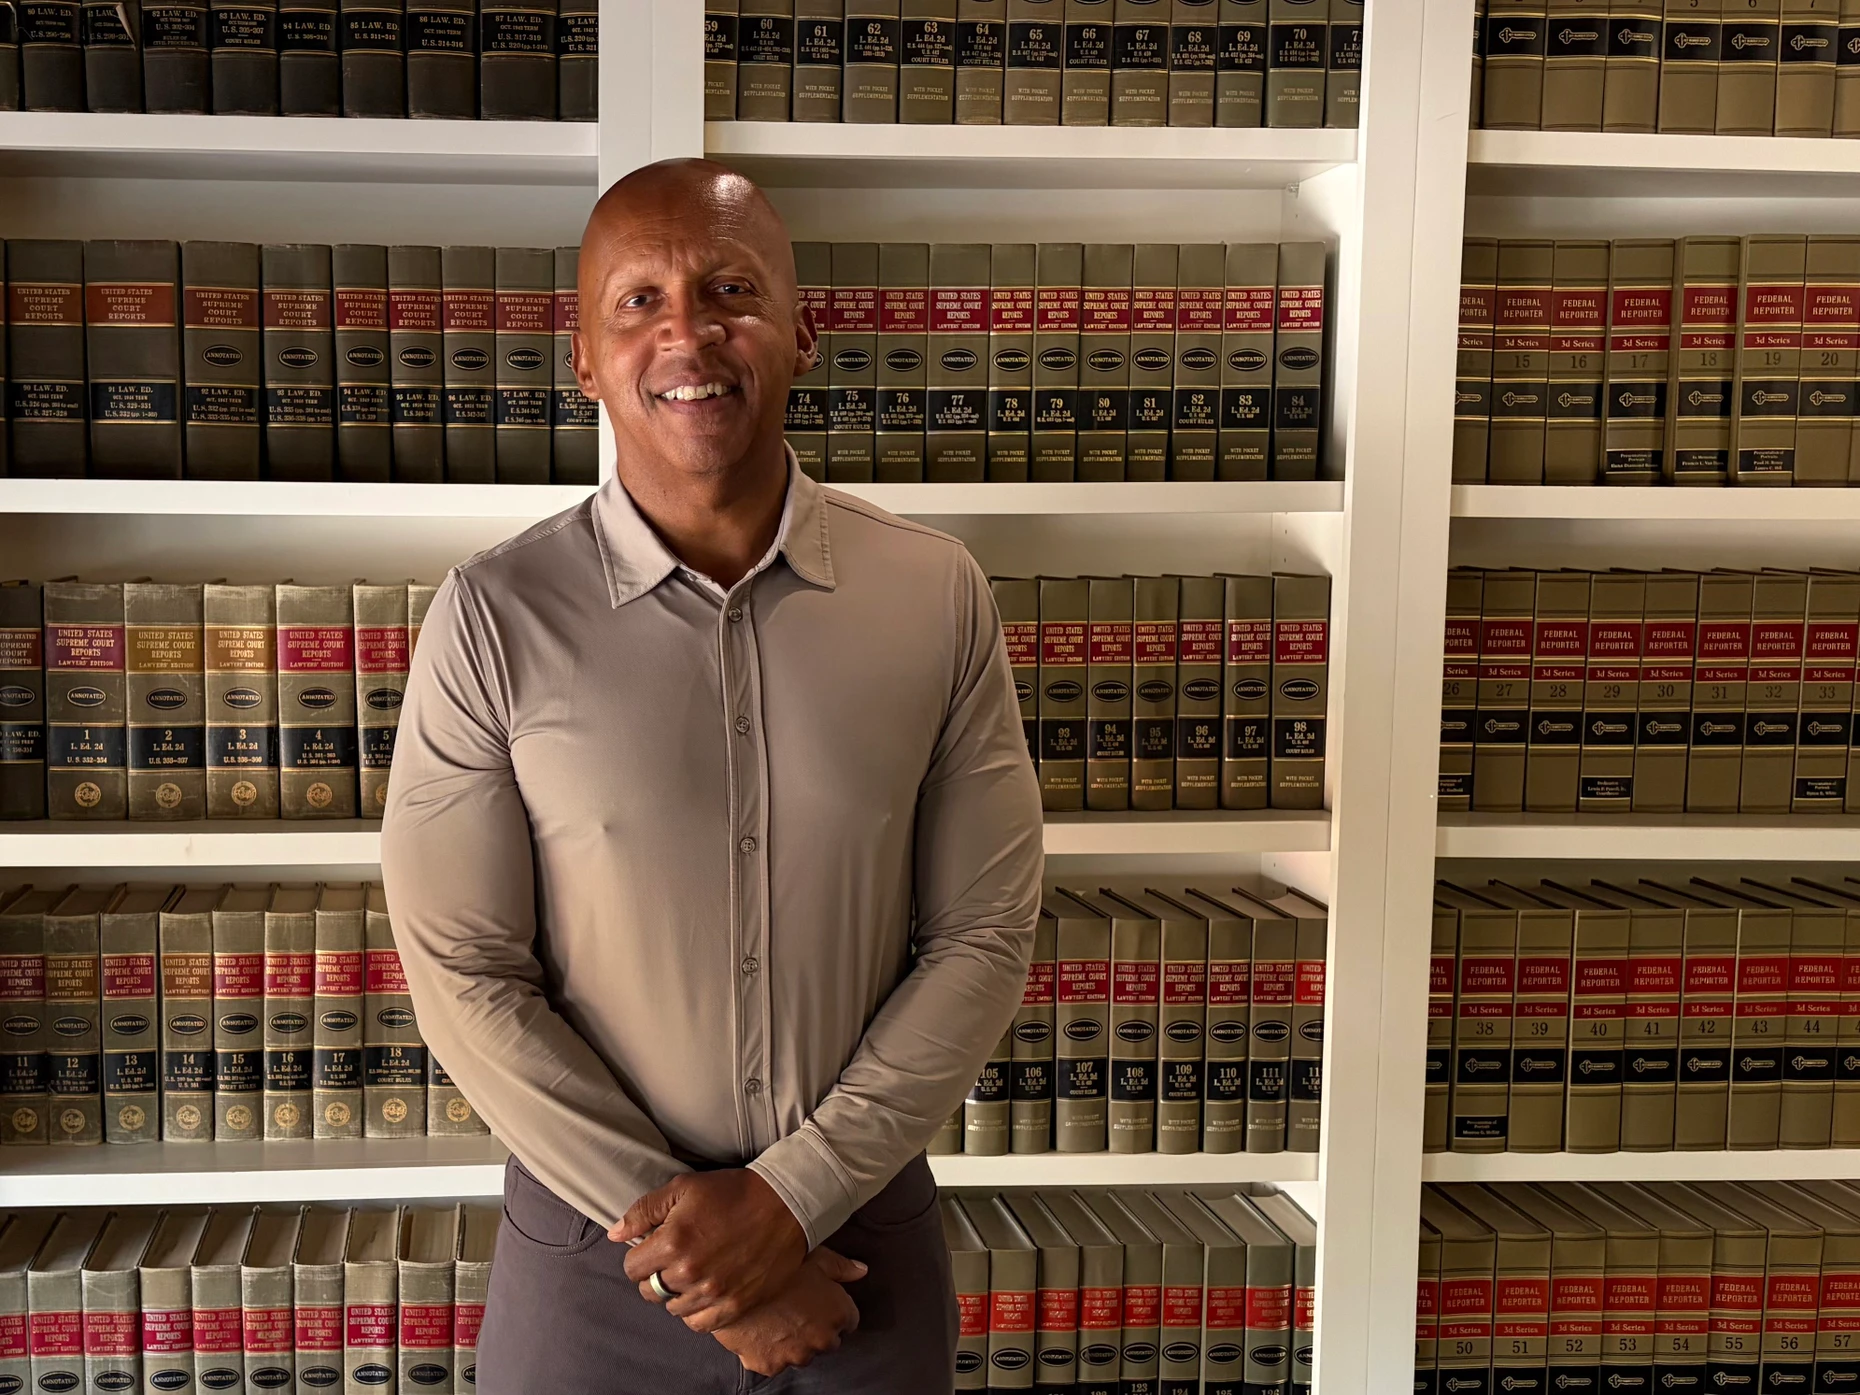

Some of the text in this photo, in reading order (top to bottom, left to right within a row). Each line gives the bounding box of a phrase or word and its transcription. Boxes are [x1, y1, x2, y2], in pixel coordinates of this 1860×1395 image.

[253, 13, 266, 21] ED.
[428, 16, 448, 24] LAW.
[451, 17, 466, 25] ED.
[761, 18, 772, 30] 60
[868, 23, 881, 34] 62
[924, 22, 938, 33] 63
[976, 24, 989, 34] 64
[814, 25, 827, 36] 61
[1030, 29, 1042, 40] 65
[1083, 28, 1096, 39] 66
[1136, 29, 1149, 40] 67
[1294, 29, 1306, 40] 70
[860, 36, 888, 44] L. Ed. 2d
[1188, 31, 1202, 42] 68
[1237, 30, 1250, 42] 69
[938, 292, 981, 300] UNITED STATES
[1757, 295, 1792, 303] FEDERAL
[936, 302, 981, 310] SUPREME COURT
[1754, 307, 1795, 315] REPORTER
[1755, 336, 1790, 344] 3d Series
[1515, 355, 1530, 367] 15
[1571, 356, 1587, 368] 16
[1631, 355, 1648, 367] 17
[1701, 353, 1717, 365] 18
[1765, 352, 1781, 365] 19
[1821, 353, 1838, 365] 20
[798, 393, 810, 404] 74
[846, 391, 858, 401] 75
[896, 393, 909, 403] 76
[952, 395, 964, 405] 77
[1191, 394, 1204, 404] 82
[1239, 395, 1252, 405] 83
[1005, 398, 1018, 408] 78
[1098, 398, 1110, 408] 80
[1144, 398, 1156, 408] 81
[1544, 630, 1578, 638] FEDERAL
[1541, 641, 1579, 649] REPORTER
[1496, 684, 1513, 696] 27
[1550, 685, 1567, 697] 28
[1604, 686, 1620, 698] 29
[1658, 685, 1674, 697] 30
[1712, 686, 1727, 699] 31
[1765, 686, 1782, 698] 32
[1819, 686, 1835, 698] 33
[1105, 724, 1116, 733] 94
[1196, 726, 1208, 735] 96
[1245, 726, 1256, 735] 97
[1294, 722, 1307, 731] 98
[84, 730, 90, 739] 1
[165, 730, 172, 740] 2
[240, 729, 246, 739] 3
[315, 730, 322, 739] 4
[383, 731, 389, 740] 5
[1476, 1023, 1493, 1035] 38
[1532, 1023, 1548, 1035] 39
[1590, 1023, 1607, 1036] 40
[1644, 1022, 1659, 1035] 41
[1698, 1021, 1715, 1033] 42
[1752, 1021, 1768, 1033] 43
[1804, 1020, 1820, 1033] 44
[390, 1048, 402, 1057] 18
[17, 1057, 28, 1067] 11
[67, 1058, 78, 1068] 12
[125, 1056, 138, 1065] 13
[183, 1055, 194, 1064] 14
[232, 1054, 244, 1064] 15
[282, 1053, 293, 1063] 16
[333, 1053, 345, 1063] 17
[1025, 1067, 1042, 1077] 106
[1076, 1062, 1093, 1072] 107
[1175, 1065, 1192, 1074] 109
[1220, 1068, 1236, 1077] 110
[1262, 1068, 1279, 1077] 111
[1719, 1284, 1755, 1292] FEDERAL
[1716, 1294, 1757, 1302] REPORTER
[146, 1313, 190, 1322] UNITED STATES
[145, 1323, 171, 1331] SUPREME
[1729, 1322, 1753, 1330] Series
[1566, 1340, 1583, 1352] 52
[1619, 1339, 1636, 1351] 53
[1673, 1338, 1689, 1351] 54
[1725, 1337, 1743, 1349] 55
[1781, 1337, 1798, 1349] 56
[1834, 1335, 1851, 1347] 57
[1457, 1342, 1473, 1354] 50
[1512, 1341, 1528, 1353] 51
[1132, 1382, 1147, 1392] 123
